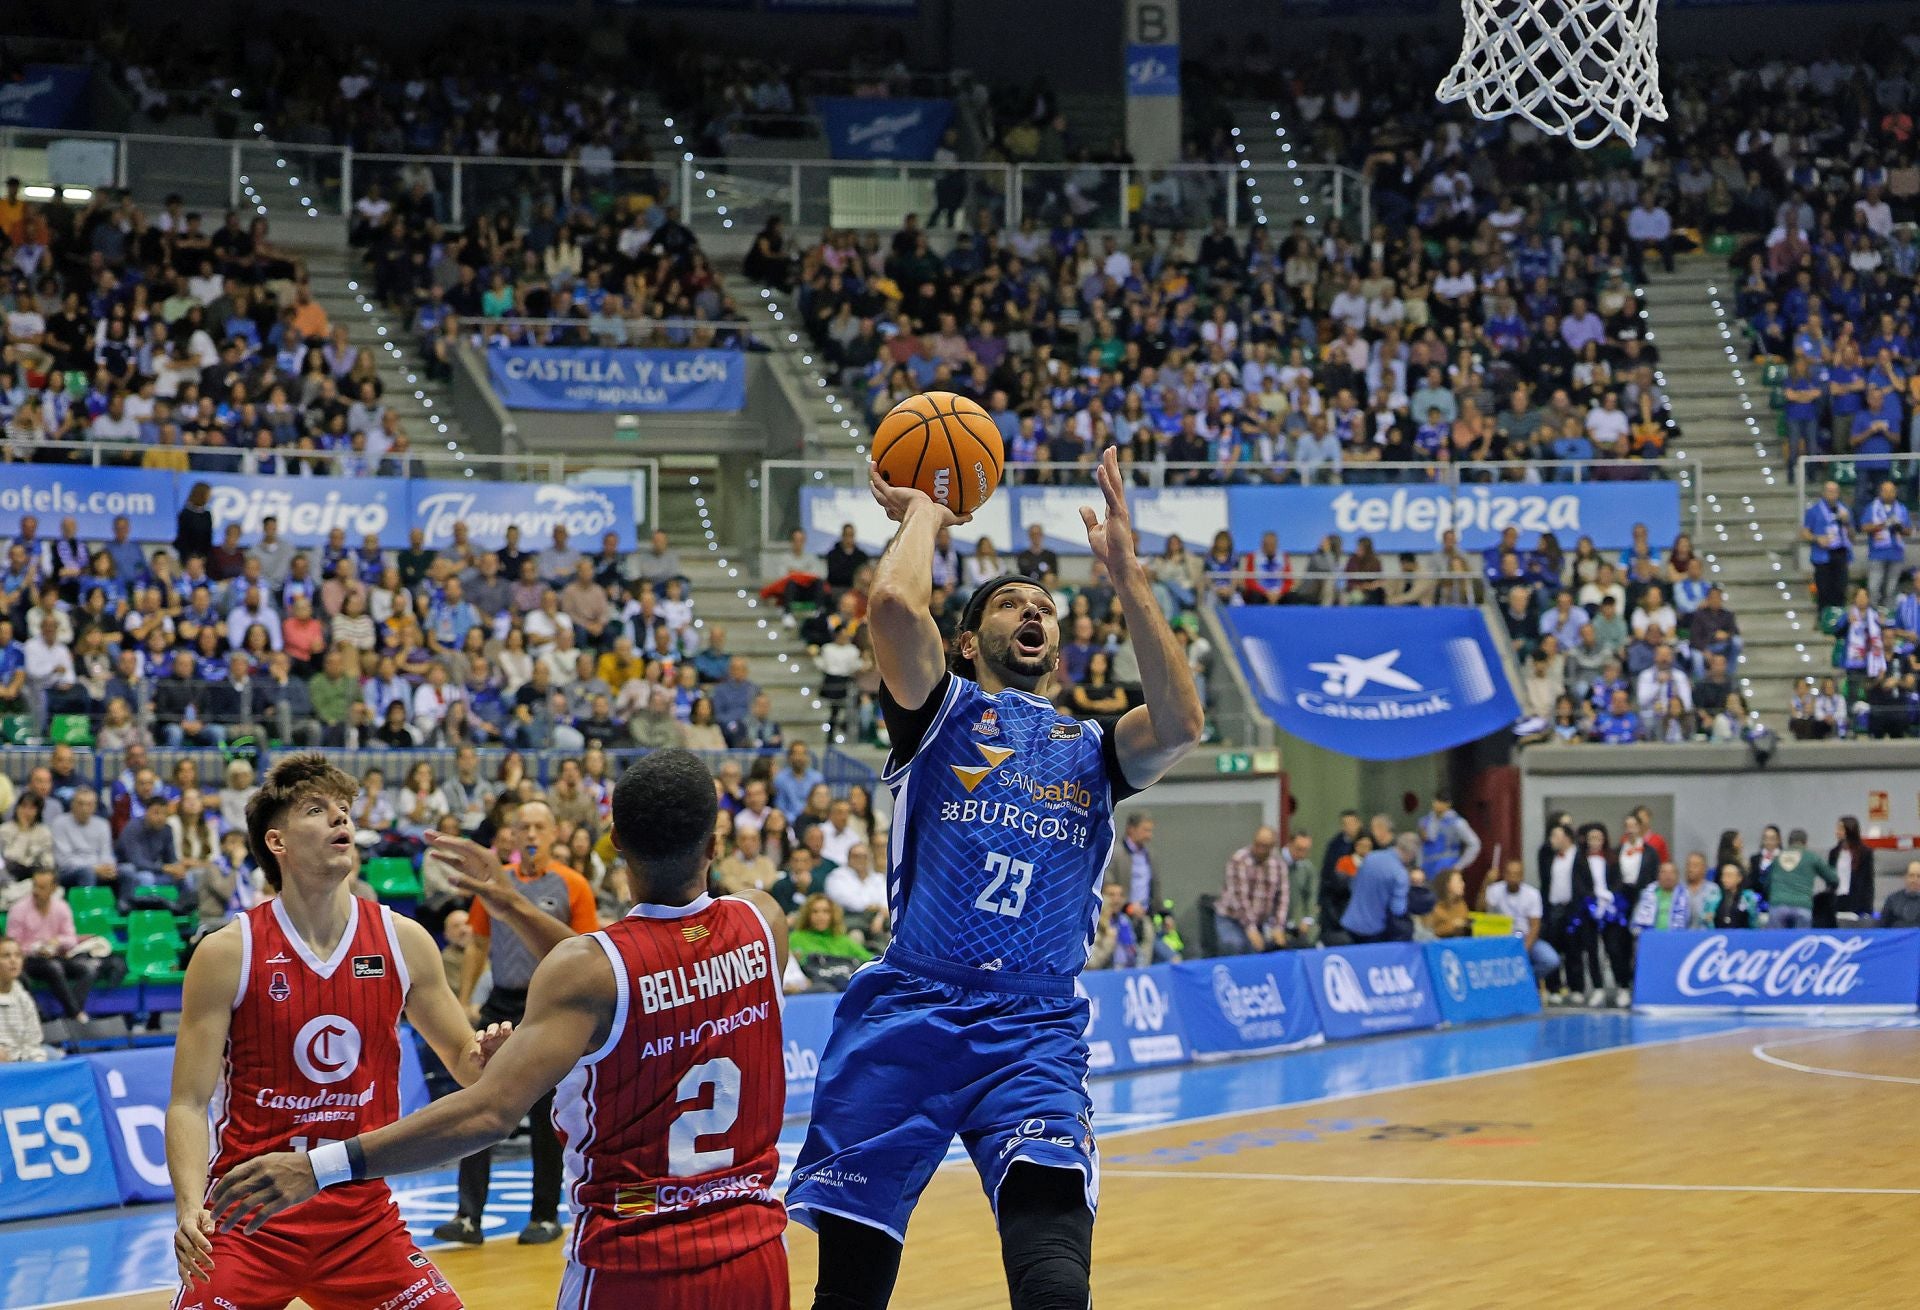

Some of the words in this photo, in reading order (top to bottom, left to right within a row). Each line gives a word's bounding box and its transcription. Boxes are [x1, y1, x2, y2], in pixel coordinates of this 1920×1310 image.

[1138, 5, 1167, 43] B
[505, 357, 625, 383] CASTILLA
[634, 360, 655, 386] Y
[660, 352, 728, 385] LEÓN
[1331, 485, 1580, 543] telepizza
[1297, 691, 1451, 721] CaixaBank
[997, 769, 1034, 793] SAN
[1031, 779, 1092, 808] pablo
[960, 799, 1069, 841] BURGOS
[974, 851, 1034, 918] 23
[638, 939, 767, 1015] BELL-HAYNES
[1676, 934, 1874, 998] Coca-Cola
[641, 1036, 674, 1060] AIR
[293, 1110, 356, 1124] ZARAGOZA
[668, 1056, 742, 1178] 2
[0, 1102, 92, 1182] ES
[843, 1172, 868, 1185] LEÓN
[380, 1278, 429, 1310] Zaragoza
